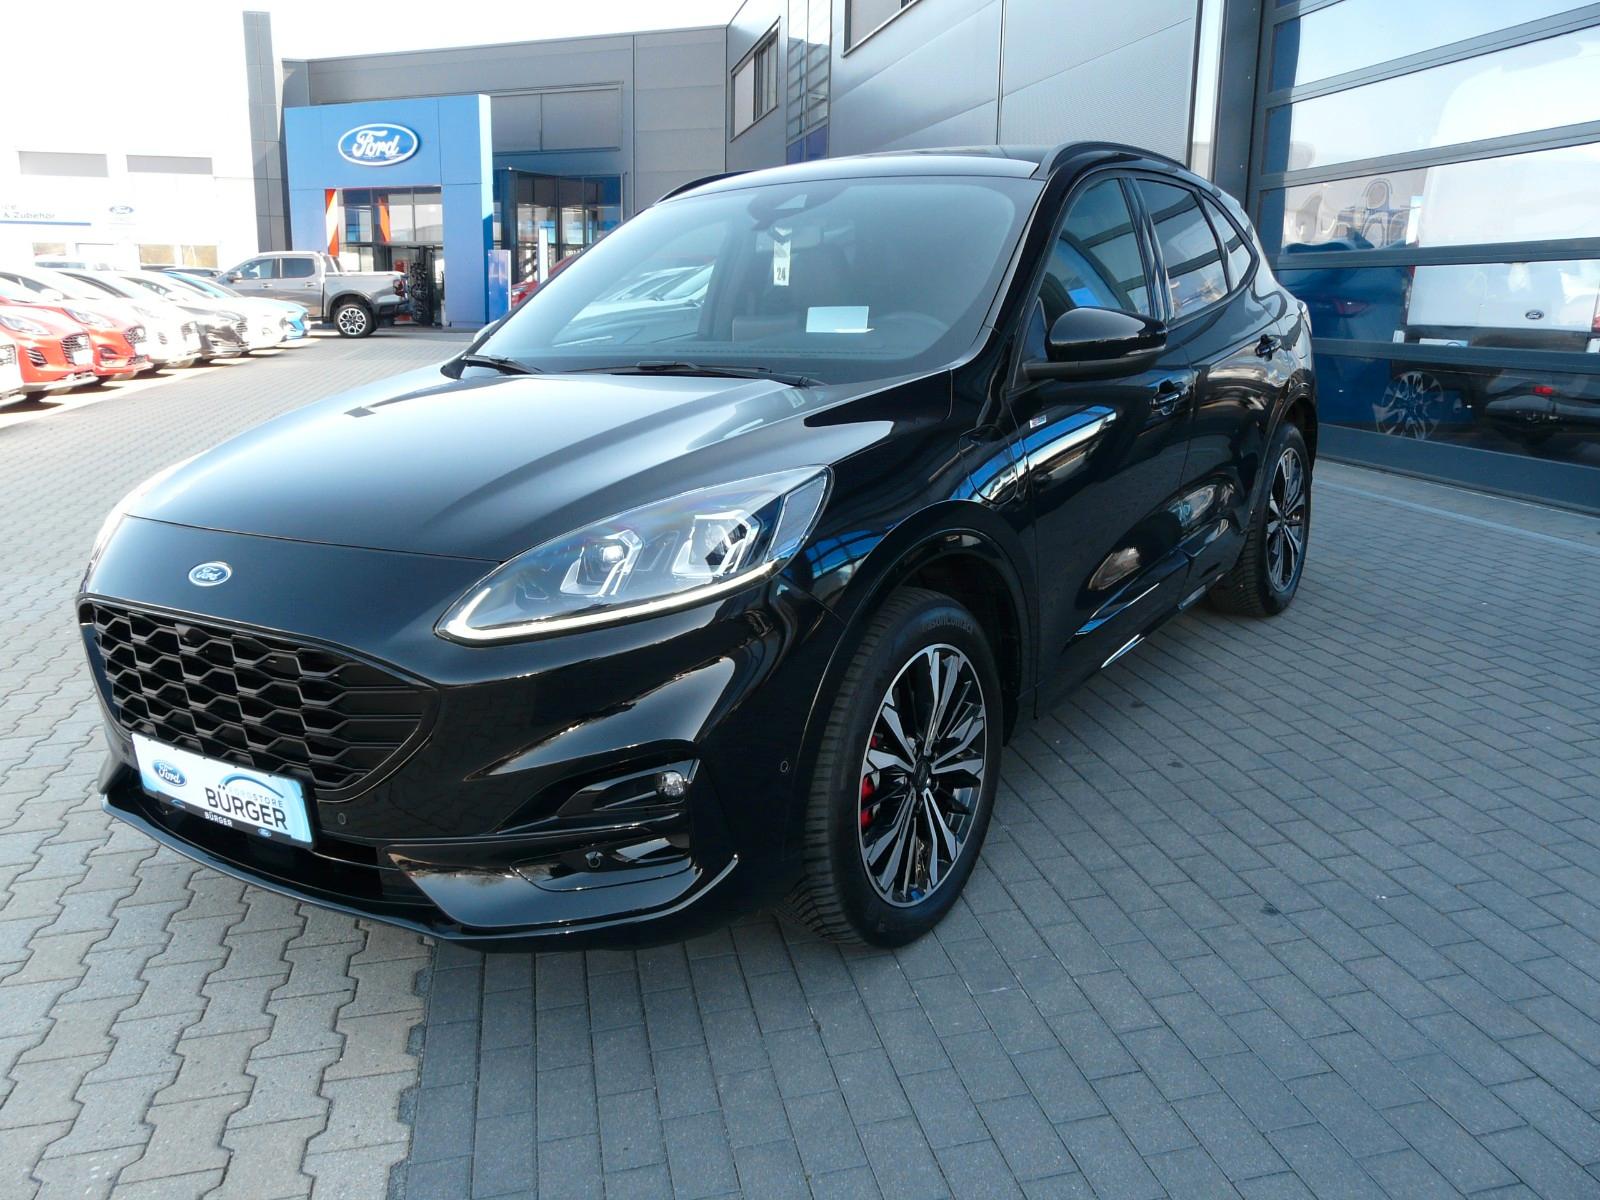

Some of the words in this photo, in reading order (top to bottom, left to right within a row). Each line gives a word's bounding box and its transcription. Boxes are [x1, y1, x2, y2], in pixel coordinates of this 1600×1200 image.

[352, 129, 401, 158] Ford
[196, 566, 222, 581] Ford
[158, 762, 182, 785] Ford
[205, 784, 288, 830] BÜRGER
